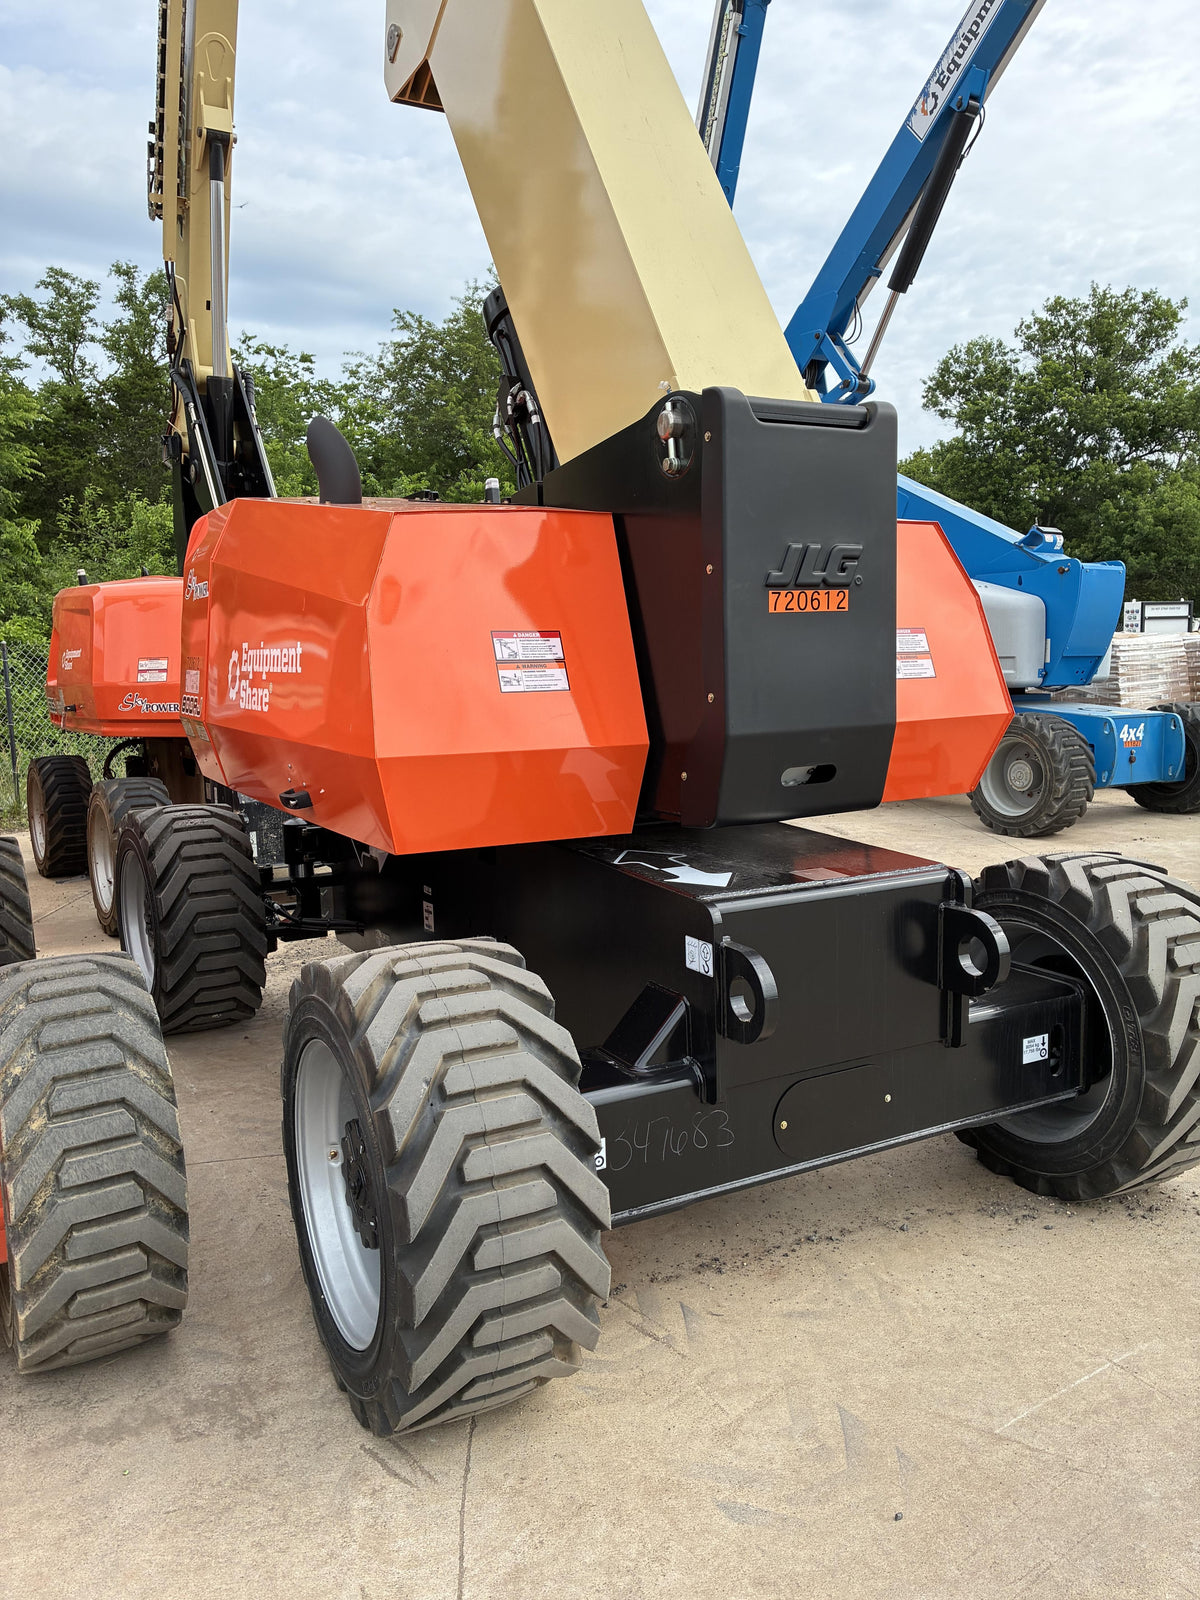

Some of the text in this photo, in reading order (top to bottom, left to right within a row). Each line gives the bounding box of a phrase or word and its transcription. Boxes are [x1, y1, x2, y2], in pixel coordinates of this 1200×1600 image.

[764, 543, 863, 587] JLG
[771, 590, 847, 612] 720612
[241, 641, 303, 680] Equipment
[239, 680, 270, 712] Share
[1120, 723, 1145, 741] 4x4
